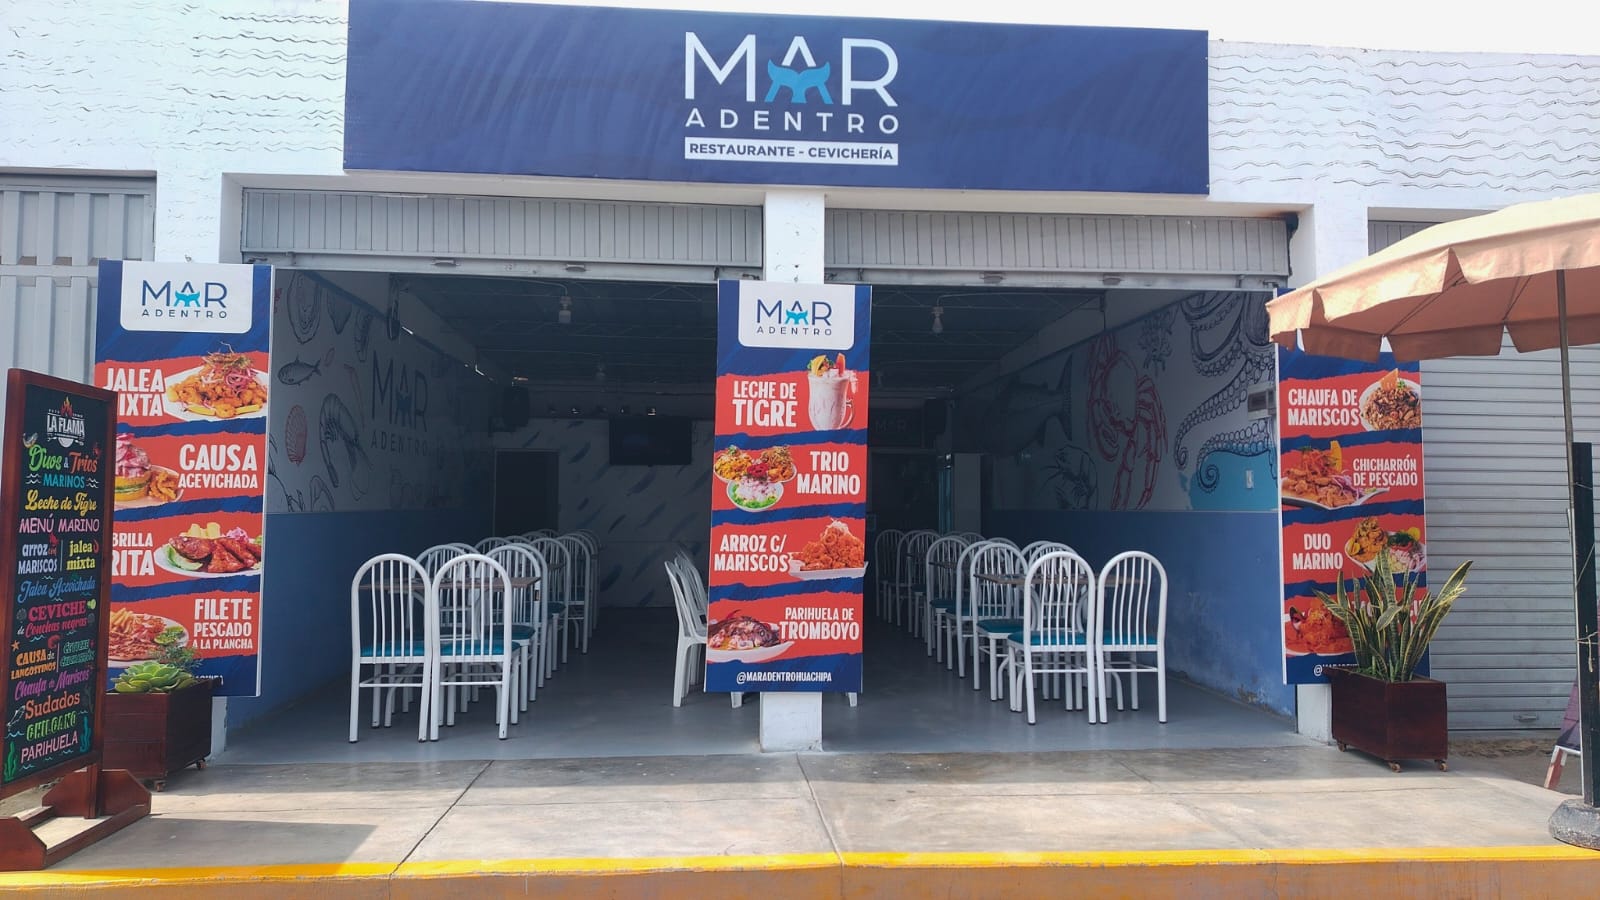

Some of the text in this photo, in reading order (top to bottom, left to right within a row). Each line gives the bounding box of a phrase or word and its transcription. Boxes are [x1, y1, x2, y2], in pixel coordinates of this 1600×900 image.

[685, 31, 899, 107] MAR
[685, 107, 900, 134] ADENTRO
[689, 142, 796, 157] RESTAURANTE
[808, 146, 894, 160] CEVICHERÍA
[141, 279, 228, 308] MAR
[141, 308, 228, 319] ADENTRO
[756, 298, 832, 326] MAR
[756, 325, 833, 336] ADENTRO
[104, 367, 164, 392] JALEA
[371, 350, 428, 433] MAR
[733, 380, 797, 400] LECHE DE
[1288, 388, 1358, 406] CHAUFA DE
[118, 393, 164, 416] IXTA
[732, 399, 798, 428] TIGRE
[46, 414, 86, 438] LA FLAMA
[1287, 407, 1360, 427] MARISCOS
[69, 451, 98, 474] Trios
[179, 444, 258, 471] CAUSA
[809, 451, 849, 472] TRIO
[1353, 454, 1417, 472] CHICHARRÓN
[43, 474, 85, 489] MARINOS
[178, 473, 259, 489] ACEVICHADA
[797, 473, 861, 495] MARINO
[1353, 471, 1418, 487] DE PESCADO
[25, 489, 97, 517] Leche de Tigre
[19, 513, 100, 534] MENÚ MARINO
[22, 543, 48, 556] arroz
[69, 540, 93, 559] jalea
[112, 532, 153, 547] BRILLA
[719, 534, 787, 553] ARROZ C/
[1303, 533, 1331, 551] DUO
[18, 558, 58, 575] MARISCOS
[66, 559, 96, 571] mixta
[111, 549, 155, 577] RITA
[714, 553, 790, 573] MARISCOS
[1292, 552, 1344, 570] MARINO
[28, 599, 87, 622] CEVICHE
[194, 598, 252, 621] FILETE
[785, 606, 855, 621] PARIHUELA DE
[193, 622, 252, 638] PESCADO
[779, 621, 860, 641] TROMBOYO
[192, 638, 253, 650] A LA PLANCHA
[16, 649, 47, 667] CAUSA
[10, 660, 57, 680] LANGOSTINOS
[736, 671, 833, 685] @MARADENTROHUACHIPA
[25, 690, 81, 720] Sudados
[20, 730, 79, 763] PARIHUELA
